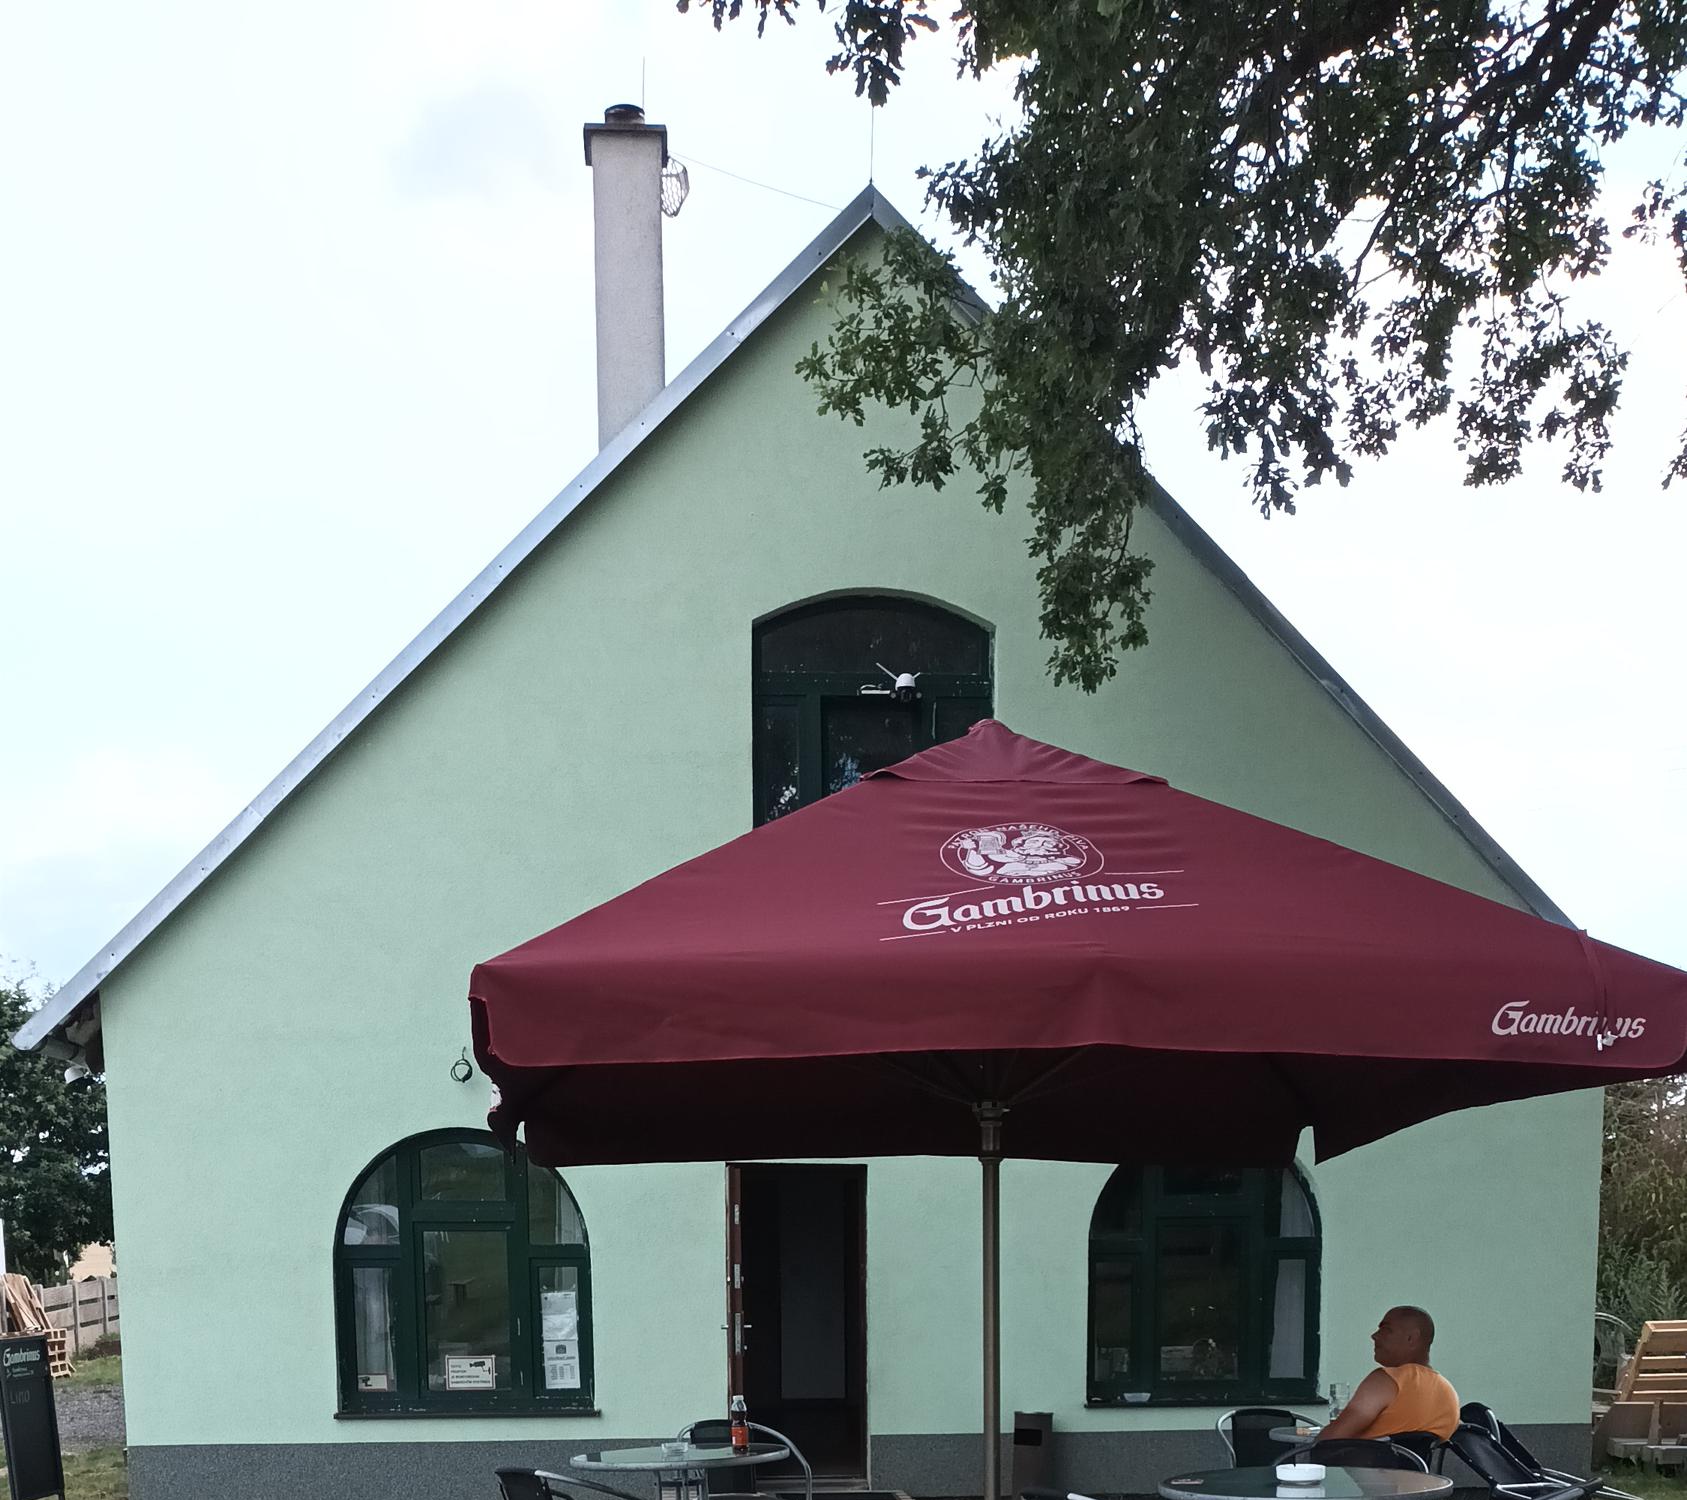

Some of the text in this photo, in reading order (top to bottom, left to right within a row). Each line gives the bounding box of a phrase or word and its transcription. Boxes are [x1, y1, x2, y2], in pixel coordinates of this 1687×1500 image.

[988, 871, 1082, 884] GAMBRINUS
[902, 880, 1165, 931] Gambrinus
[966, 919, 1013, 932] PLZNI
[1016, 914, 1041, 924] OD
[1044, 907, 1090, 919] ROKU
[1093, 905, 1131, 913] 1869
[1491, 1000, 1647, 1039] Gambrius
